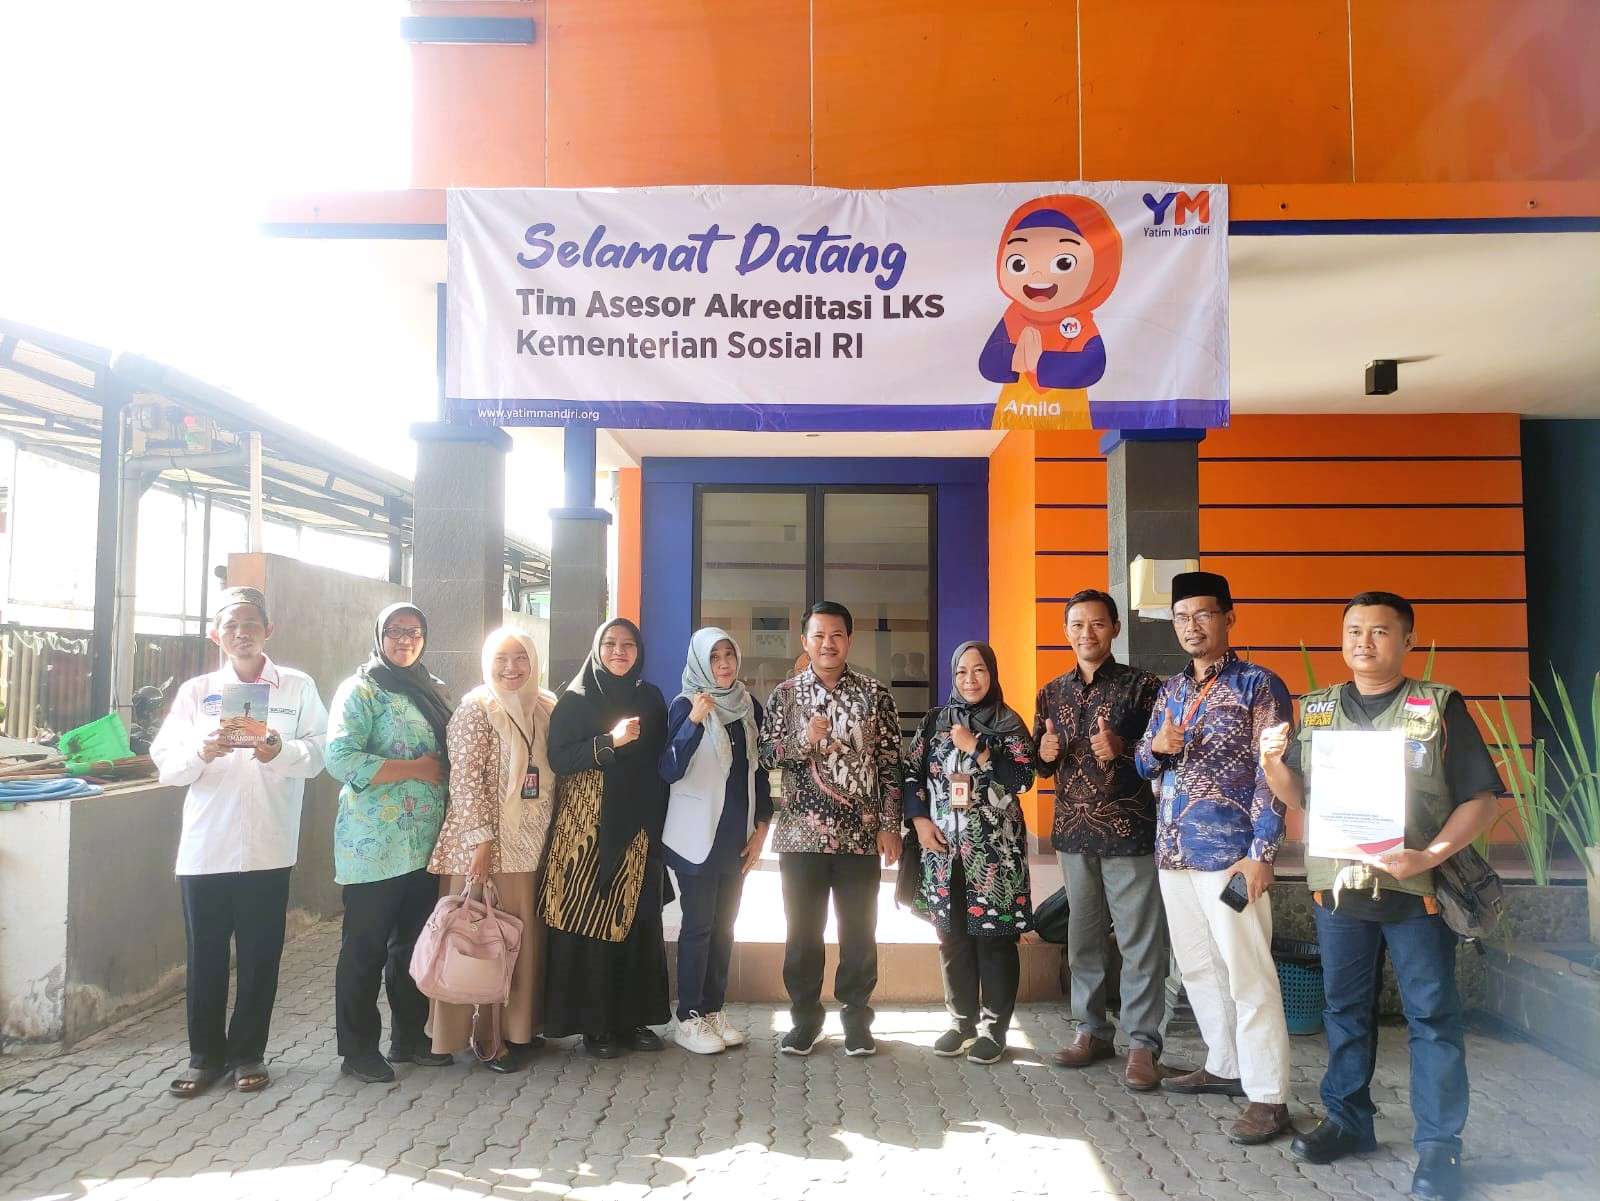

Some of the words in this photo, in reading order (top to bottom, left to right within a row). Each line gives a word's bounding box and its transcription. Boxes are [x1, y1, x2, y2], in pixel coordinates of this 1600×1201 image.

[1142, 190, 1210, 225] YM
[1143, 227, 1171, 238] Yatim
[1173, 225, 1211, 237] Mandiri
[516, 222, 736, 274] Selamat
[735, 222, 906, 291] Datang
[516, 288, 576, 317] Tim
[585, 290, 696, 318] Asesor
[704, 293, 872, 320] Akreditasi
[882, 294, 945, 318] LKS
[1061, 322, 1078, 332] YM
[516, 329, 718, 359] Kementerian
[727, 331, 822, 359] Sosial
[832, 332, 863, 359] RI
[477, 407, 600, 421] www.yatimmandiri.org
[1003, 399, 1061, 417] Amila
[1307, 700, 1336, 713] ONE
